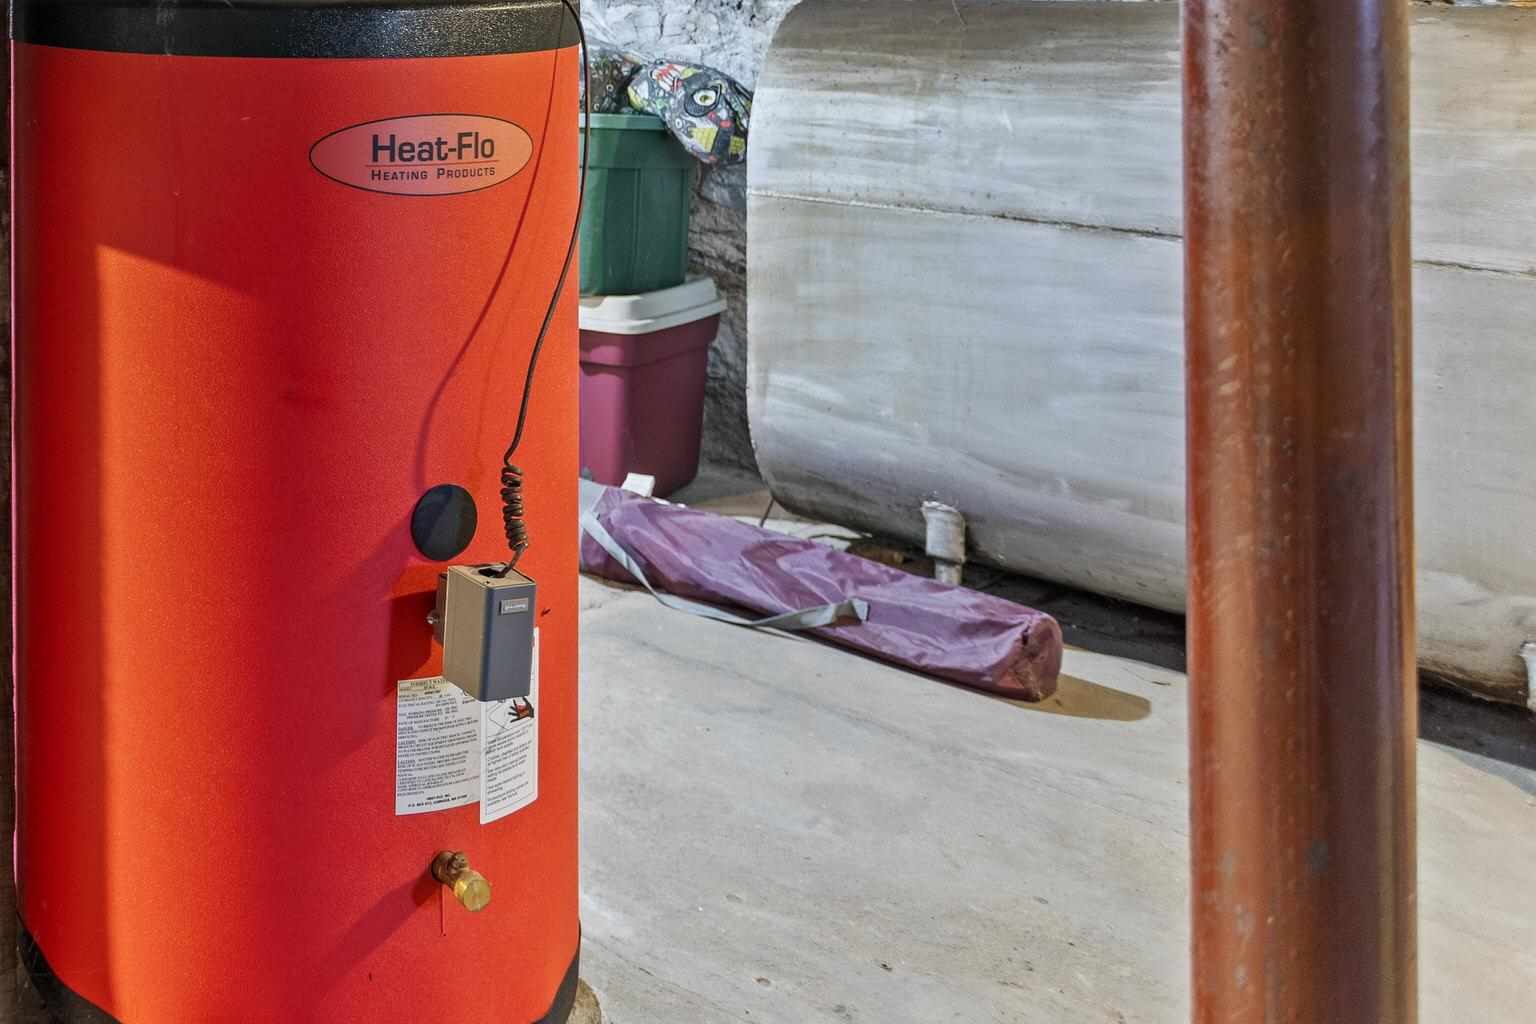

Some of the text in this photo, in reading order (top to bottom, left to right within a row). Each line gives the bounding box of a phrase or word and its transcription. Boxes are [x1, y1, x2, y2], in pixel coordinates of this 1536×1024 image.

[372, 131, 495, 162] Heat-Flo
[371, 167, 495, 181] HEATING PRODUCTS
